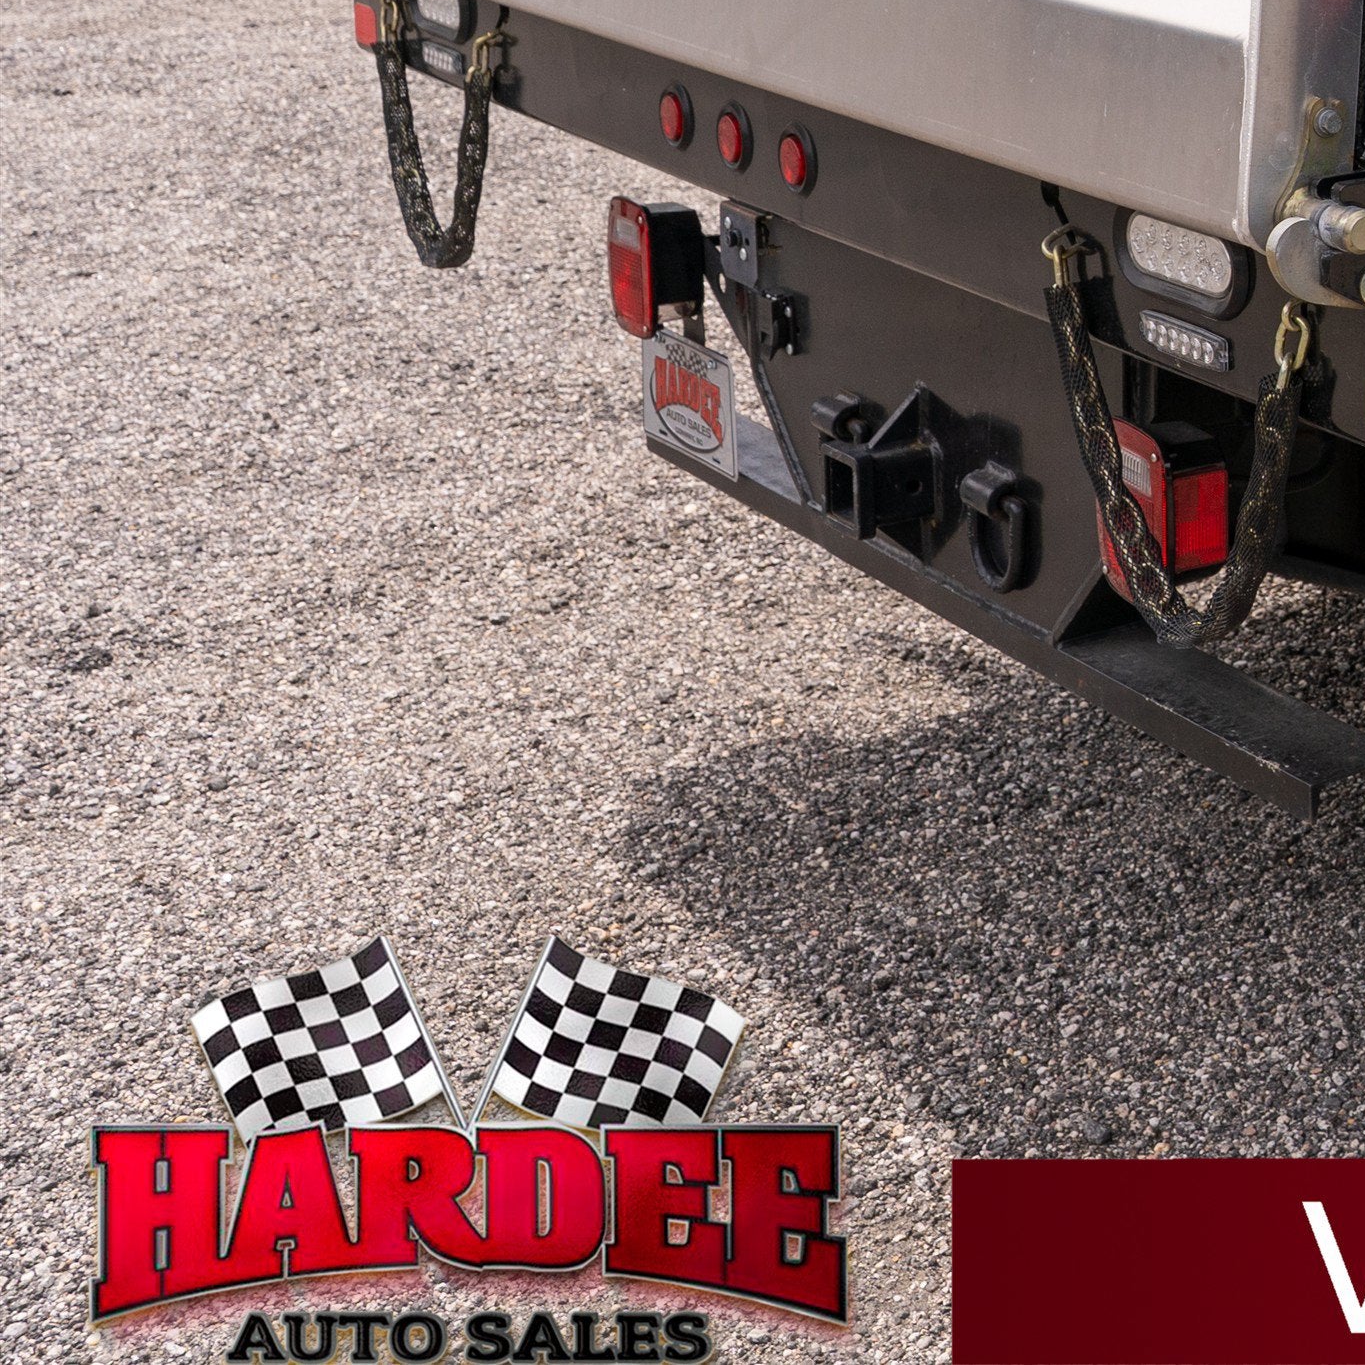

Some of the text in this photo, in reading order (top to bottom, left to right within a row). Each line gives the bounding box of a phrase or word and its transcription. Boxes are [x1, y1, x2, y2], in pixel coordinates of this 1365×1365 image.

[655, 355, 724, 447] HARDEE
[666, 407, 687, 426] AUTO
[687, 417, 713, 439] SALES
